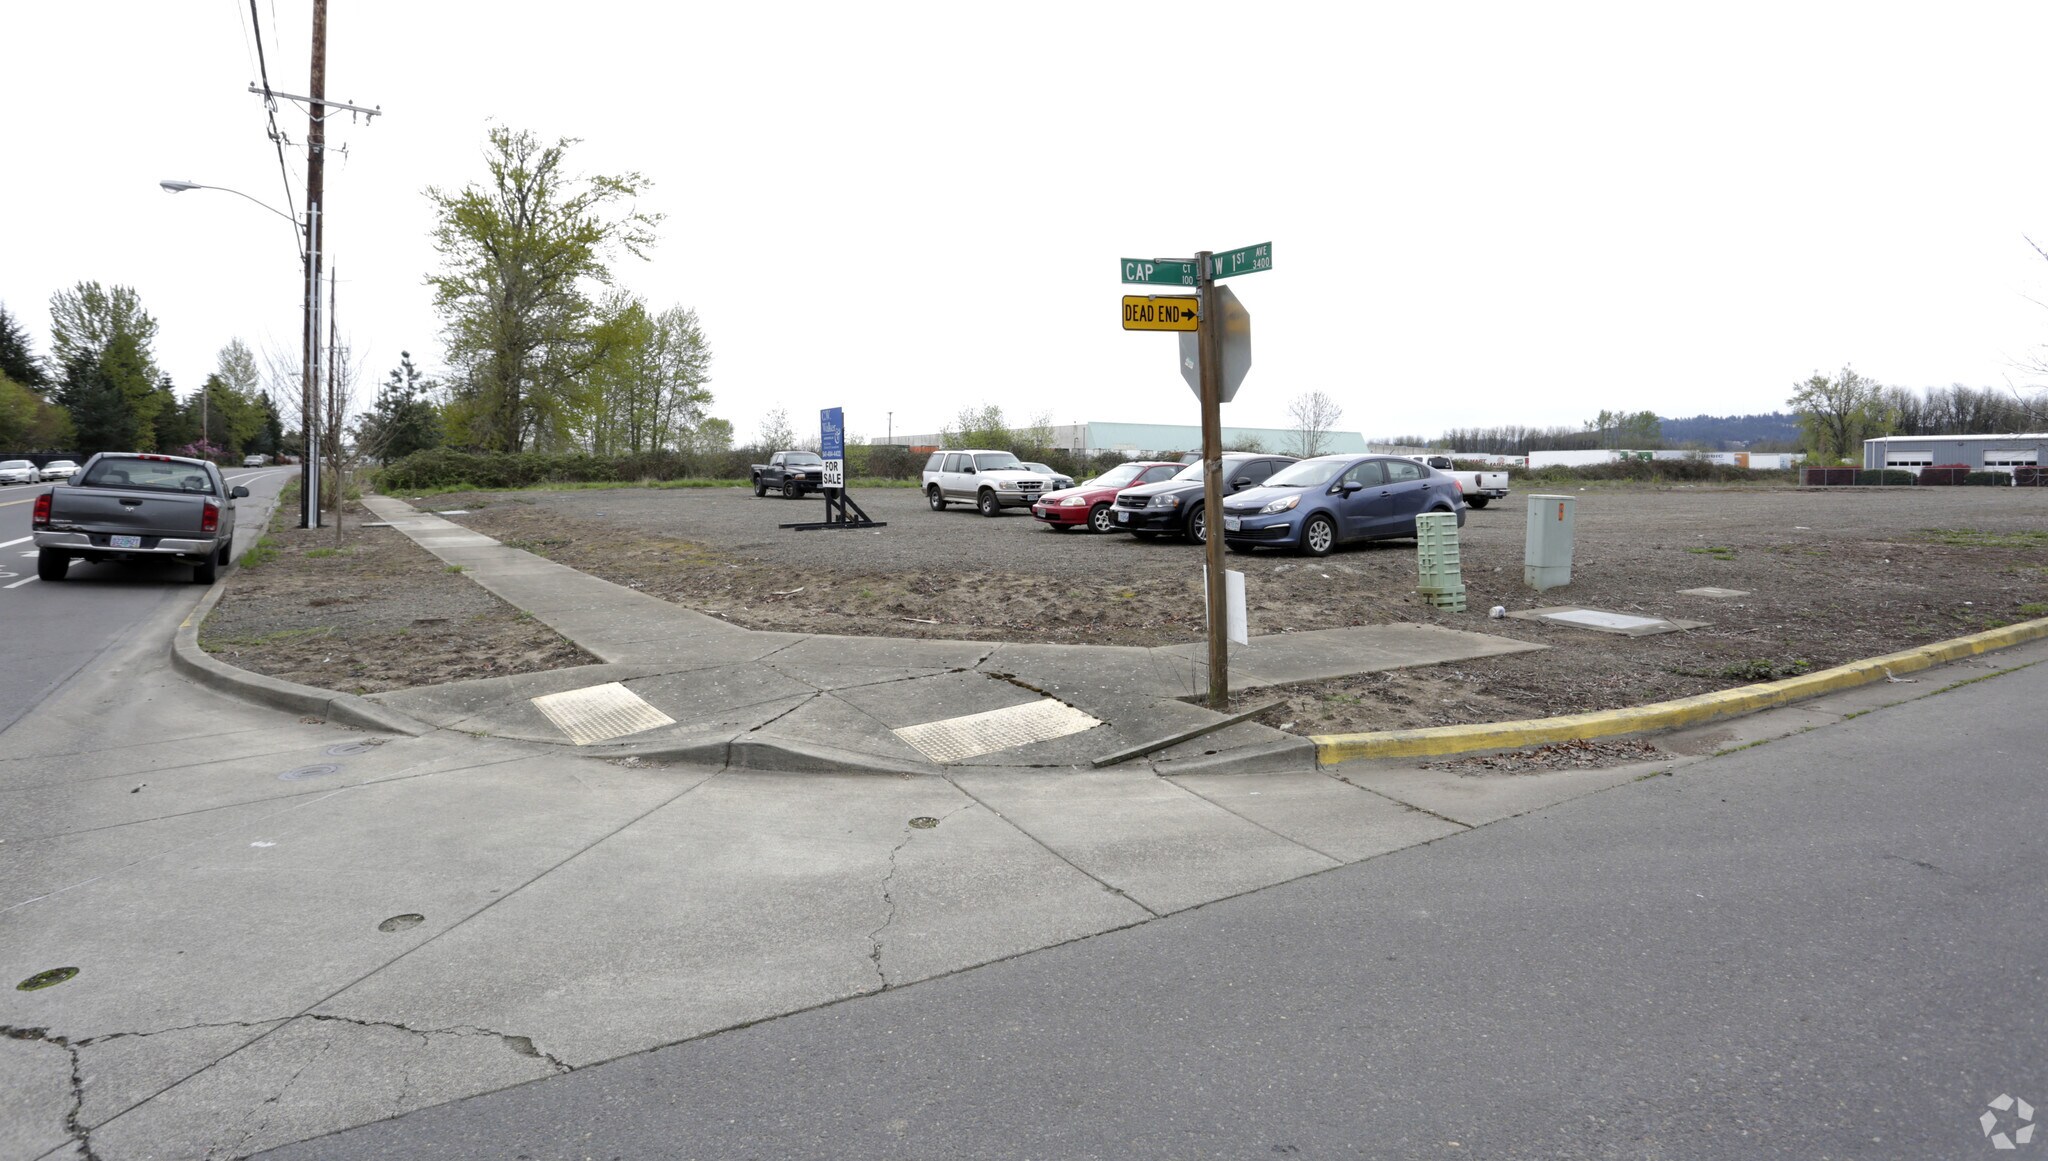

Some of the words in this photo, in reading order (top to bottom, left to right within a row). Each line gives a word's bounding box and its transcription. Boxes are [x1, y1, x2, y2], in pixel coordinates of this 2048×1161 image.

[1256, 246, 1267, 256] AVE
[1182, 264, 1191, 273] CT
[1215, 258, 1224, 275] W
[1232, 253, 1246, 272] 1ST
[1253, 258, 1270, 271] 3400
[1126, 263, 1154, 281] CAP
[1182, 276, 1193, 285] 100
[1125, 304, 1154, 322] DEAD
[1158, 305, 1180, 323] END
[825, 461, 838, 472] FOR
[823, 473, 841, 485] SALE
